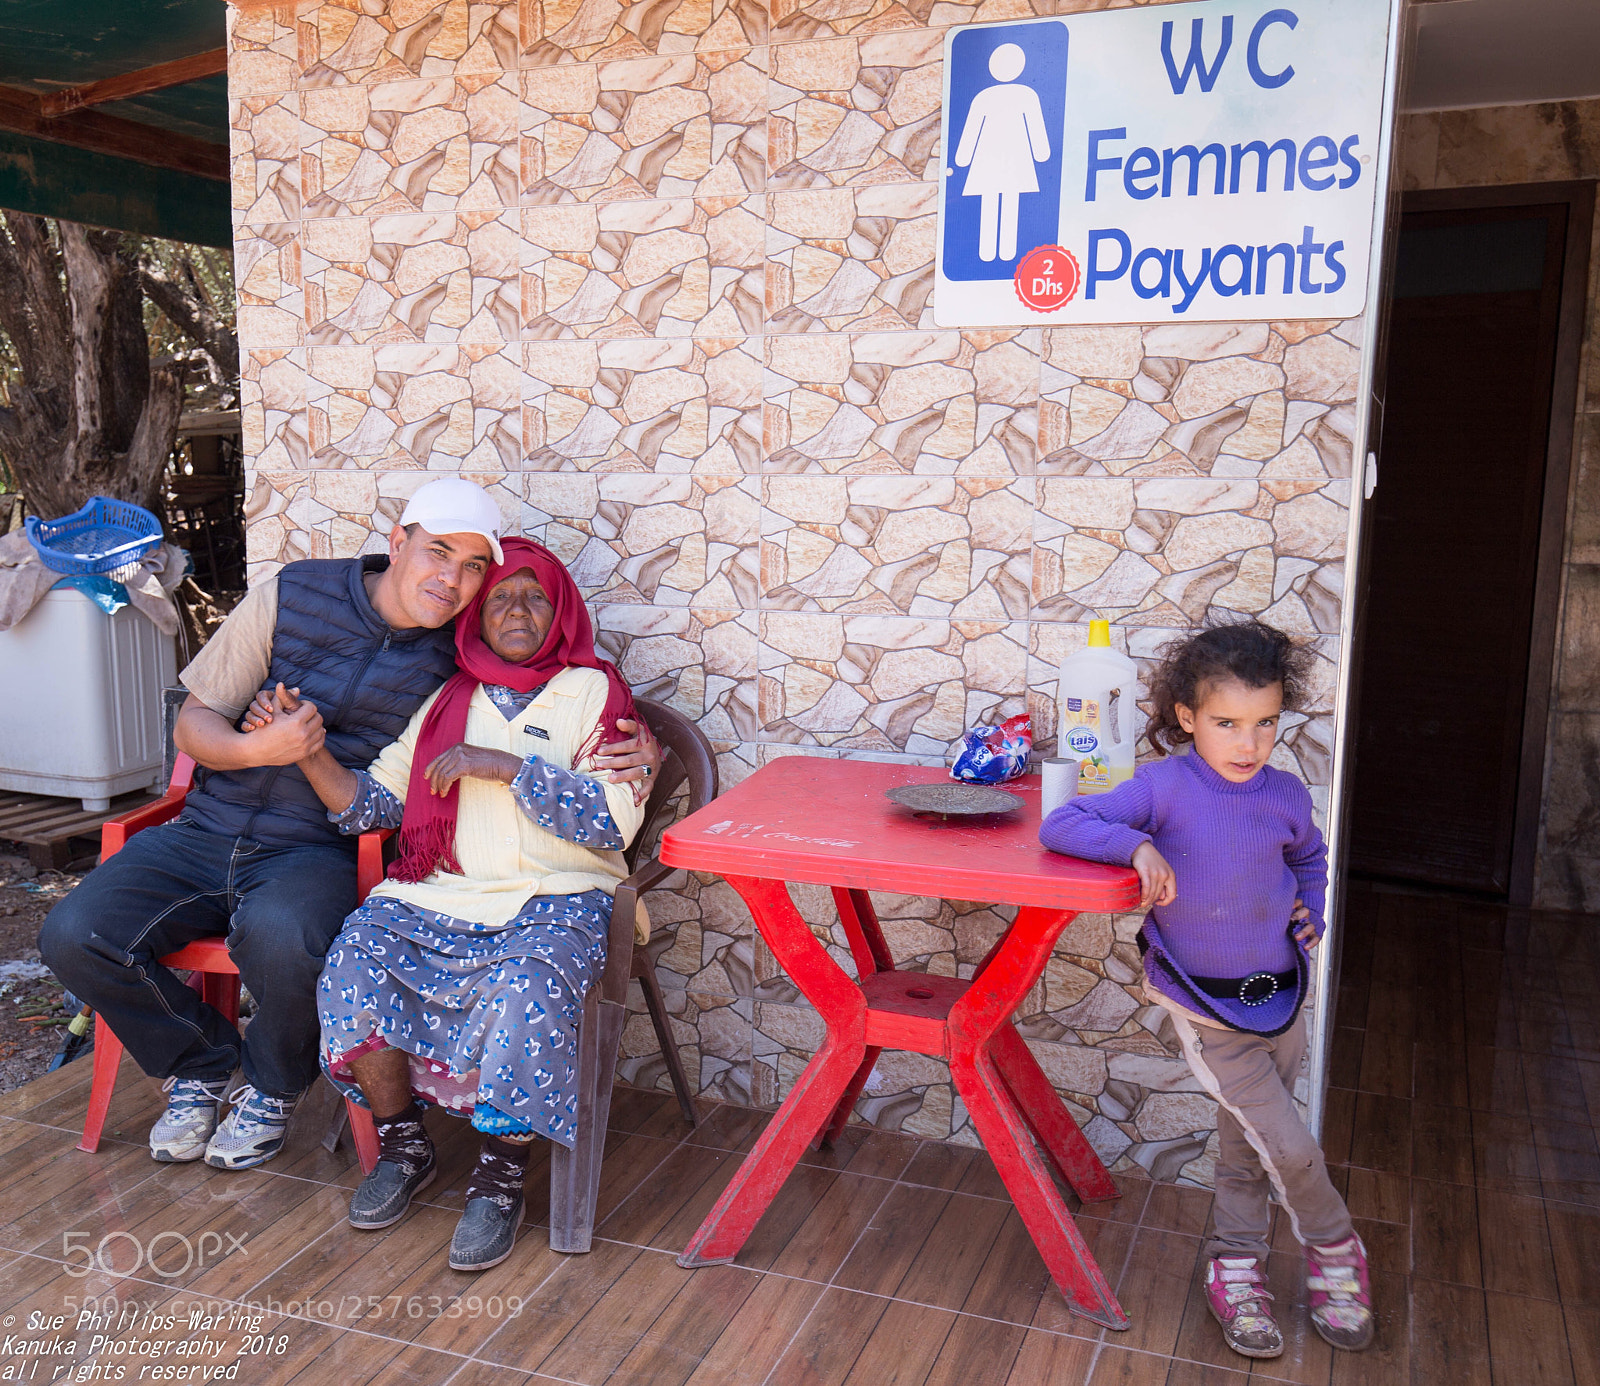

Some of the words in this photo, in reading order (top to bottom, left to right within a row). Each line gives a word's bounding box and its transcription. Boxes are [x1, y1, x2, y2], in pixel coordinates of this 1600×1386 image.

[1160, 8, 1299, 95] WC
[1084, 126, 1362, 203] Femmes
[1032, 277, 1063, 296] Dhs
[1042, 259, 1054, 275] 2
[1084, 225, 1347, 314] Payants
